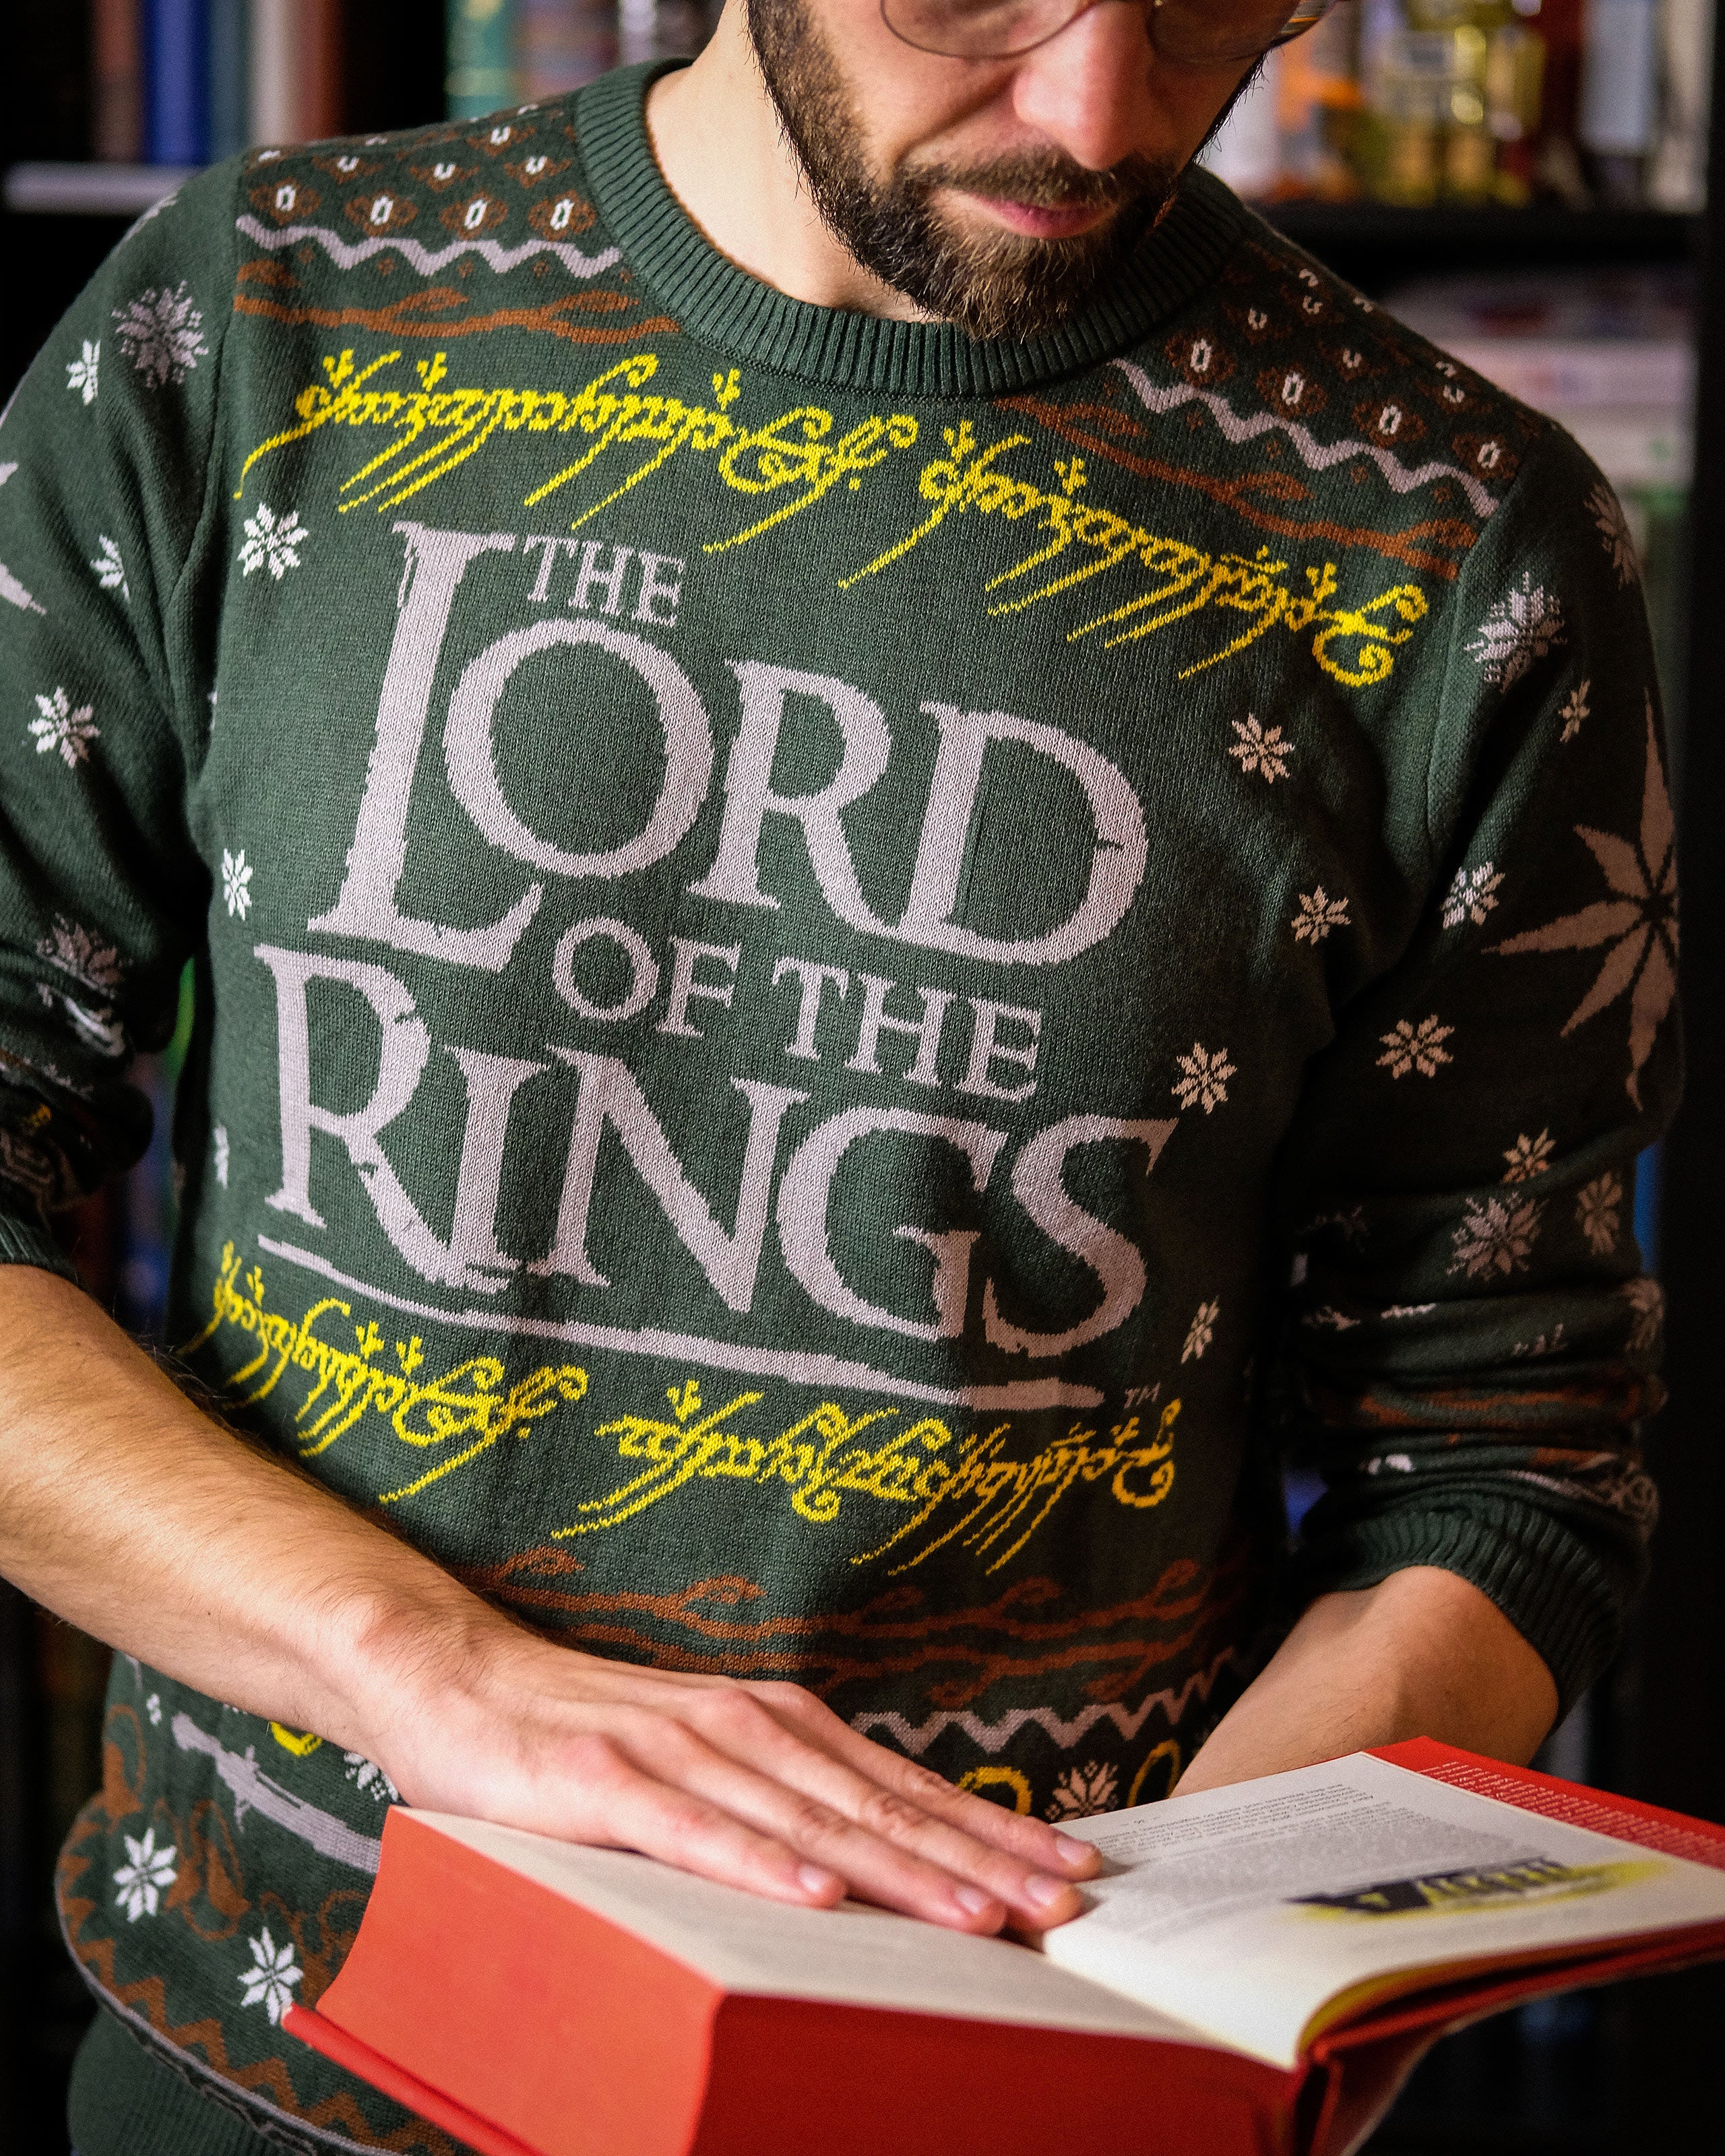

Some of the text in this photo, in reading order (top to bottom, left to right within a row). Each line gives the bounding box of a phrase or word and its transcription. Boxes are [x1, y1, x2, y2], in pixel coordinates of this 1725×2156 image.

[522, 536, 686, 627] THE
[308, 521, 1149, 972] LORD
[553, 917, 1043, 1103] OF THE
[255, 943, 1179, 1359] RINGS
[1124, 1382, 1160, 1409] TM
